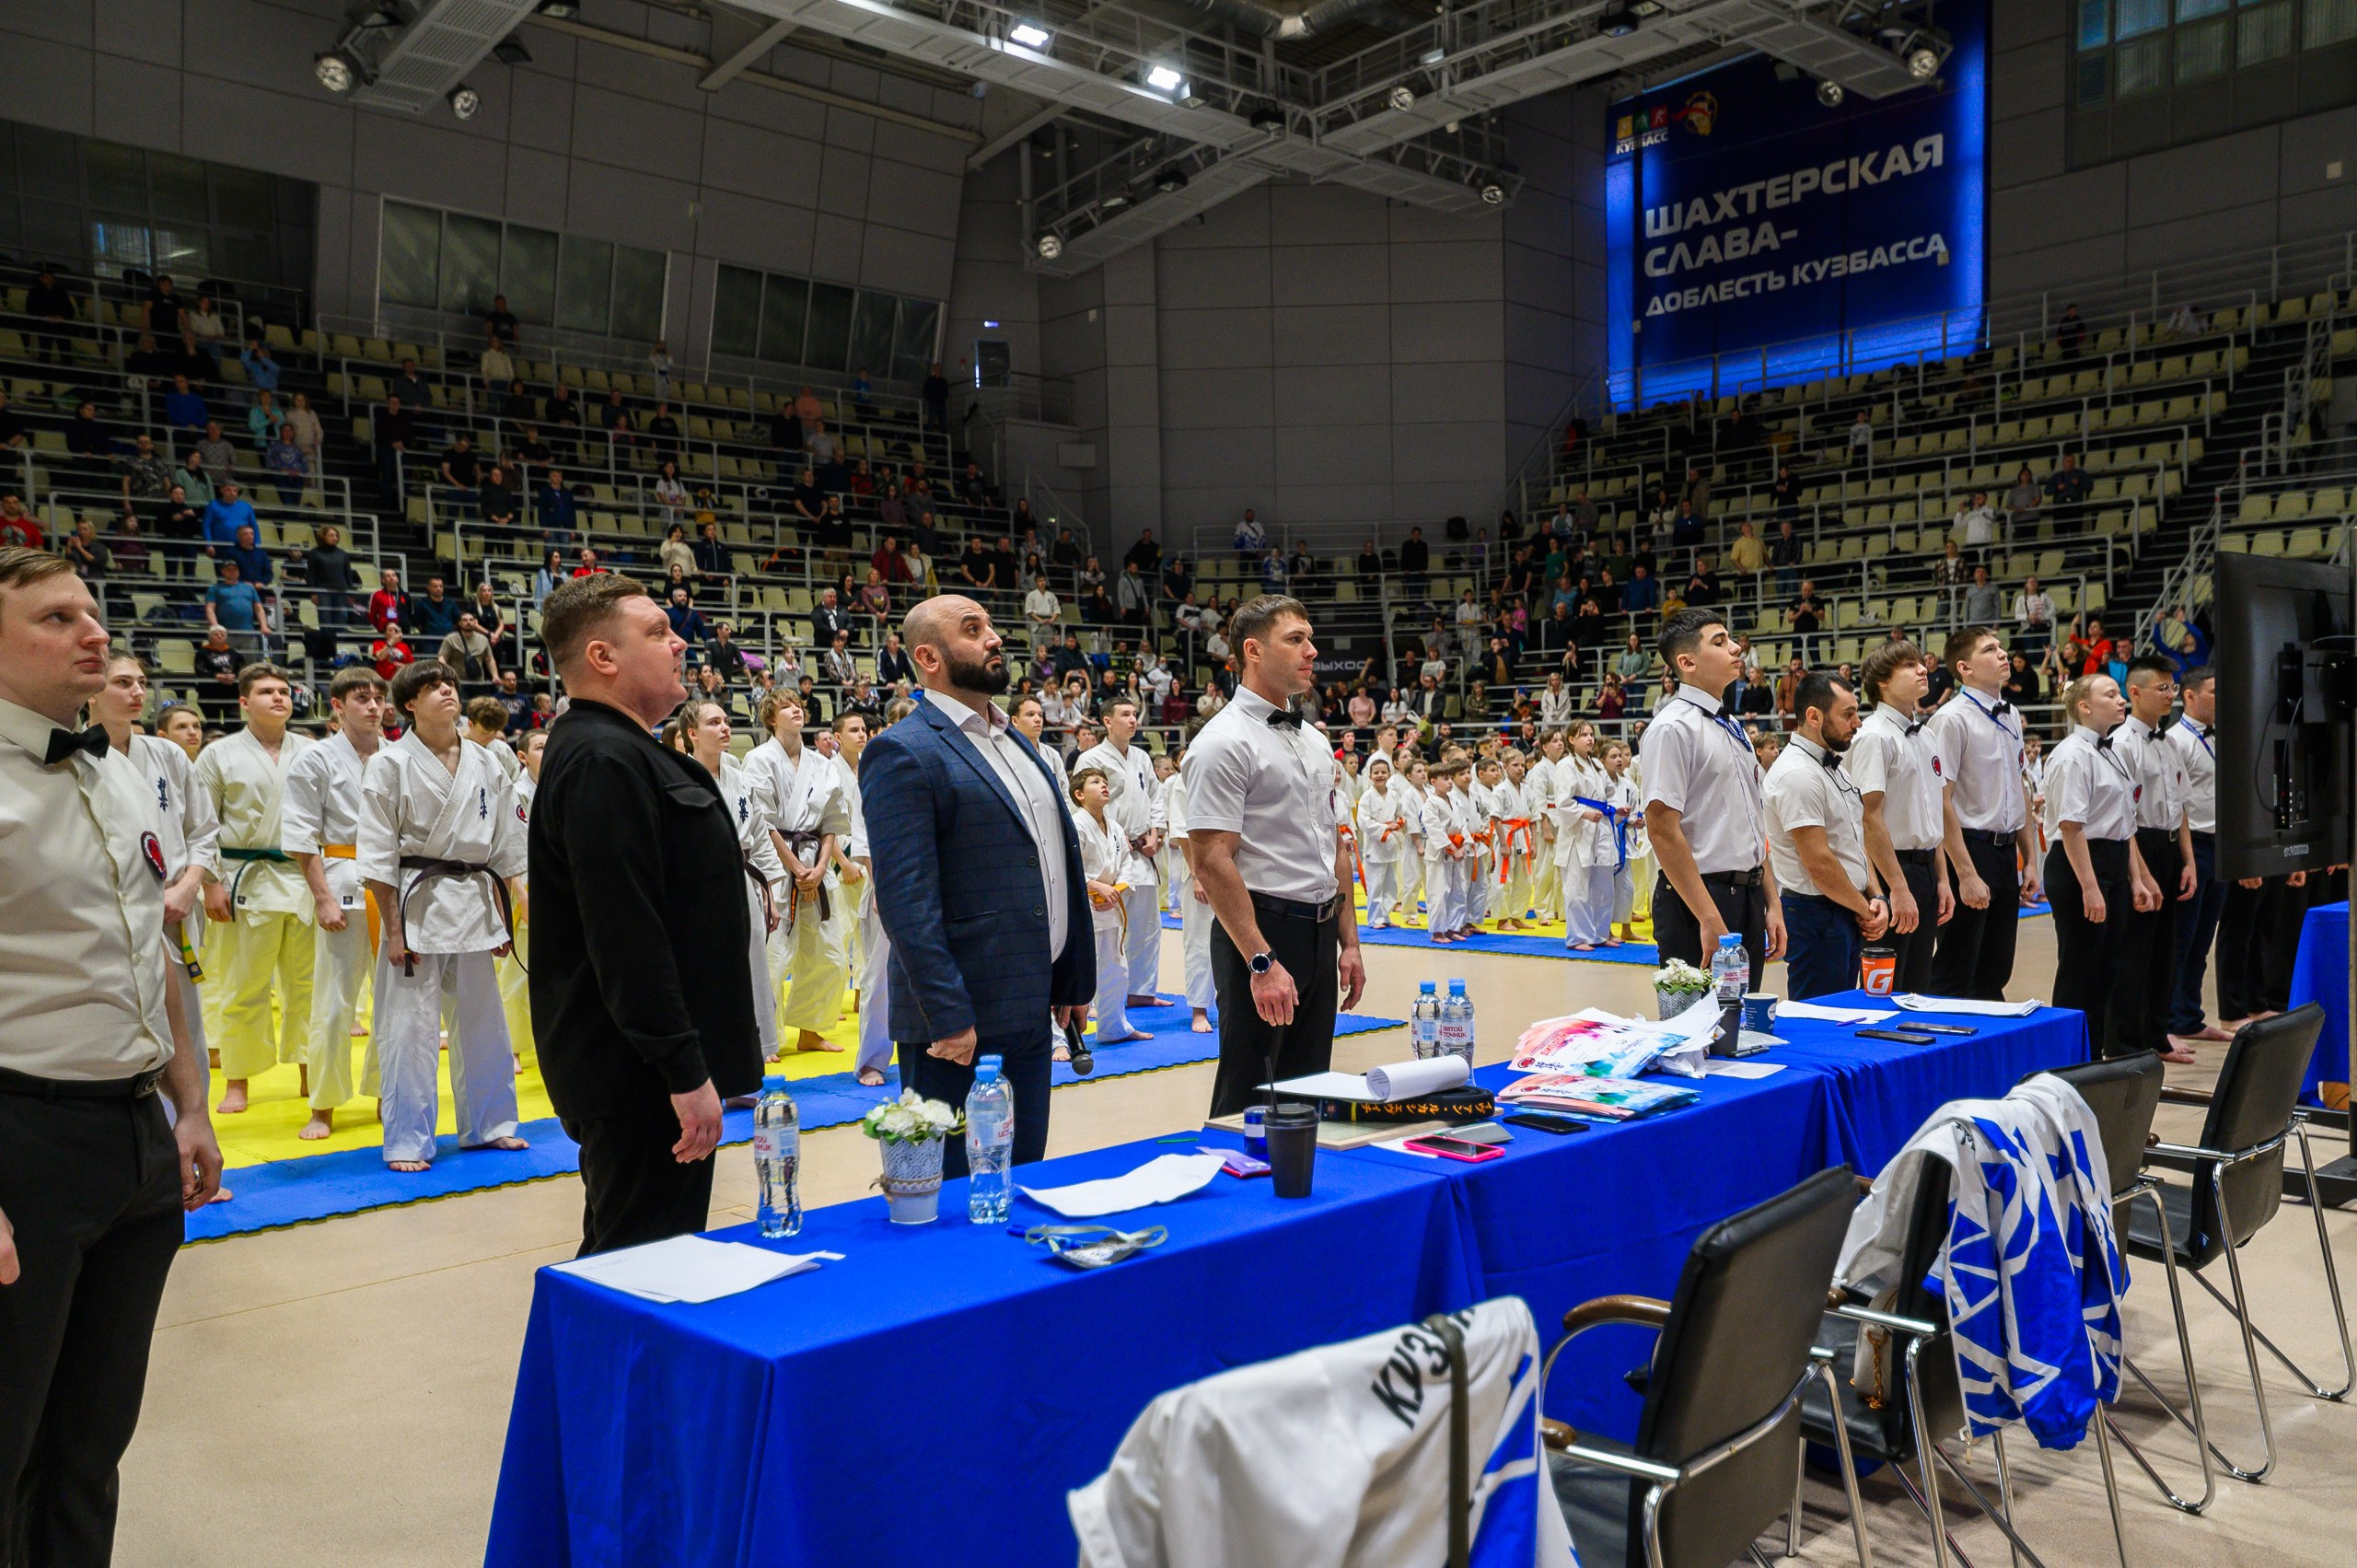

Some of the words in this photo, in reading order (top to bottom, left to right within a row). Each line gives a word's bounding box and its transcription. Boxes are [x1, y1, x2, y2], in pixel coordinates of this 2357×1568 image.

[1616, 132, 1668, 155] КУАСС
[1645, 134, 1945, 239] ШАХТЕРСКАЯ
[1645, 271, 1785, 317] ДОБЛЕСТЬ
[1793, 233, 1947, 285] КУЗБАССА
[1867, 969, 1895, 993] G
